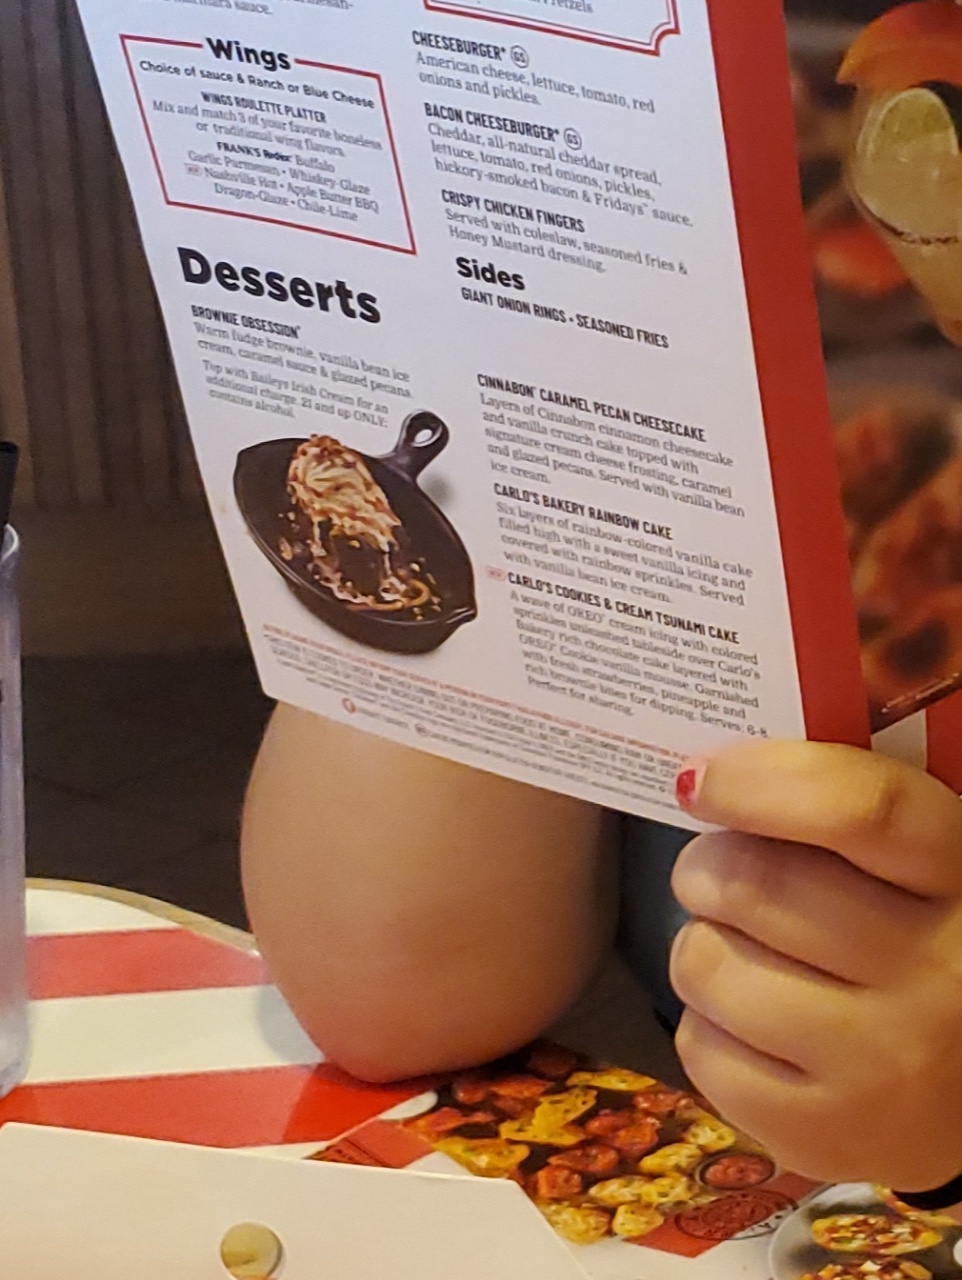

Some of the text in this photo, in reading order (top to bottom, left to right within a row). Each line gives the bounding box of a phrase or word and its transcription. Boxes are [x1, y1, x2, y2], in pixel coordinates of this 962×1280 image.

[206, 37, 291, 72] Wings
[139, 60, 375, 109] Choice of sauce & Ranch or Blue Cheese
[201, 91, 327, 123] WINGS ROULETTE PLATTER
[416, 51, 655, 113] American cheese, lettuce, tomato, red
[419, 72, 463, 89] onions
[465, 81, 491, 96] and
[424, 102, 464, 123] BACON
[428, 122, 662, 186] Cheddar, all-natural cheddar spread,
[431, 140, 655, 202] lettuce, tomato, red onions, pickles,
[434, 157, 539, 191] hickory-smoked
[540, 180, 579, 200] bacon
[582, 189, 592, 203] &
[652, 209, 693, 227] sauce.
[441, 189, 585, 233] CRISPY CHICKEN FINGERS
[445, 208, 688, 275] Served with coleslaw, seasoned fries &
[448, 225, 606, 273] Honey Mustard dressing.
[177, 247, 381, 324] Desserts
[456, 256, 525, 291] Sides
[191, 305, 240, 326] BROWNIE
[461, 287, 669, 349] GIANT ONION RINGS SEASONED FRIES
[539, 388, 592, 413] CARAMEL
[593, 401, 631, 423] PECAN
[633, 412, 706, 442] CHEESECAKE
[494, 482, 673, 540] CARLO'S BAKERY RAINBOW CAKE
[507, 572, 553, 594] CARLO'S
[555, 584, 601, 608] COOKIES
[603, 597, 613, 610] &
[615, 601, 653, 621] CREAM
[655, 611, 706, 636] TSUNAMI
[708, 626, 740, 644] CAKE
